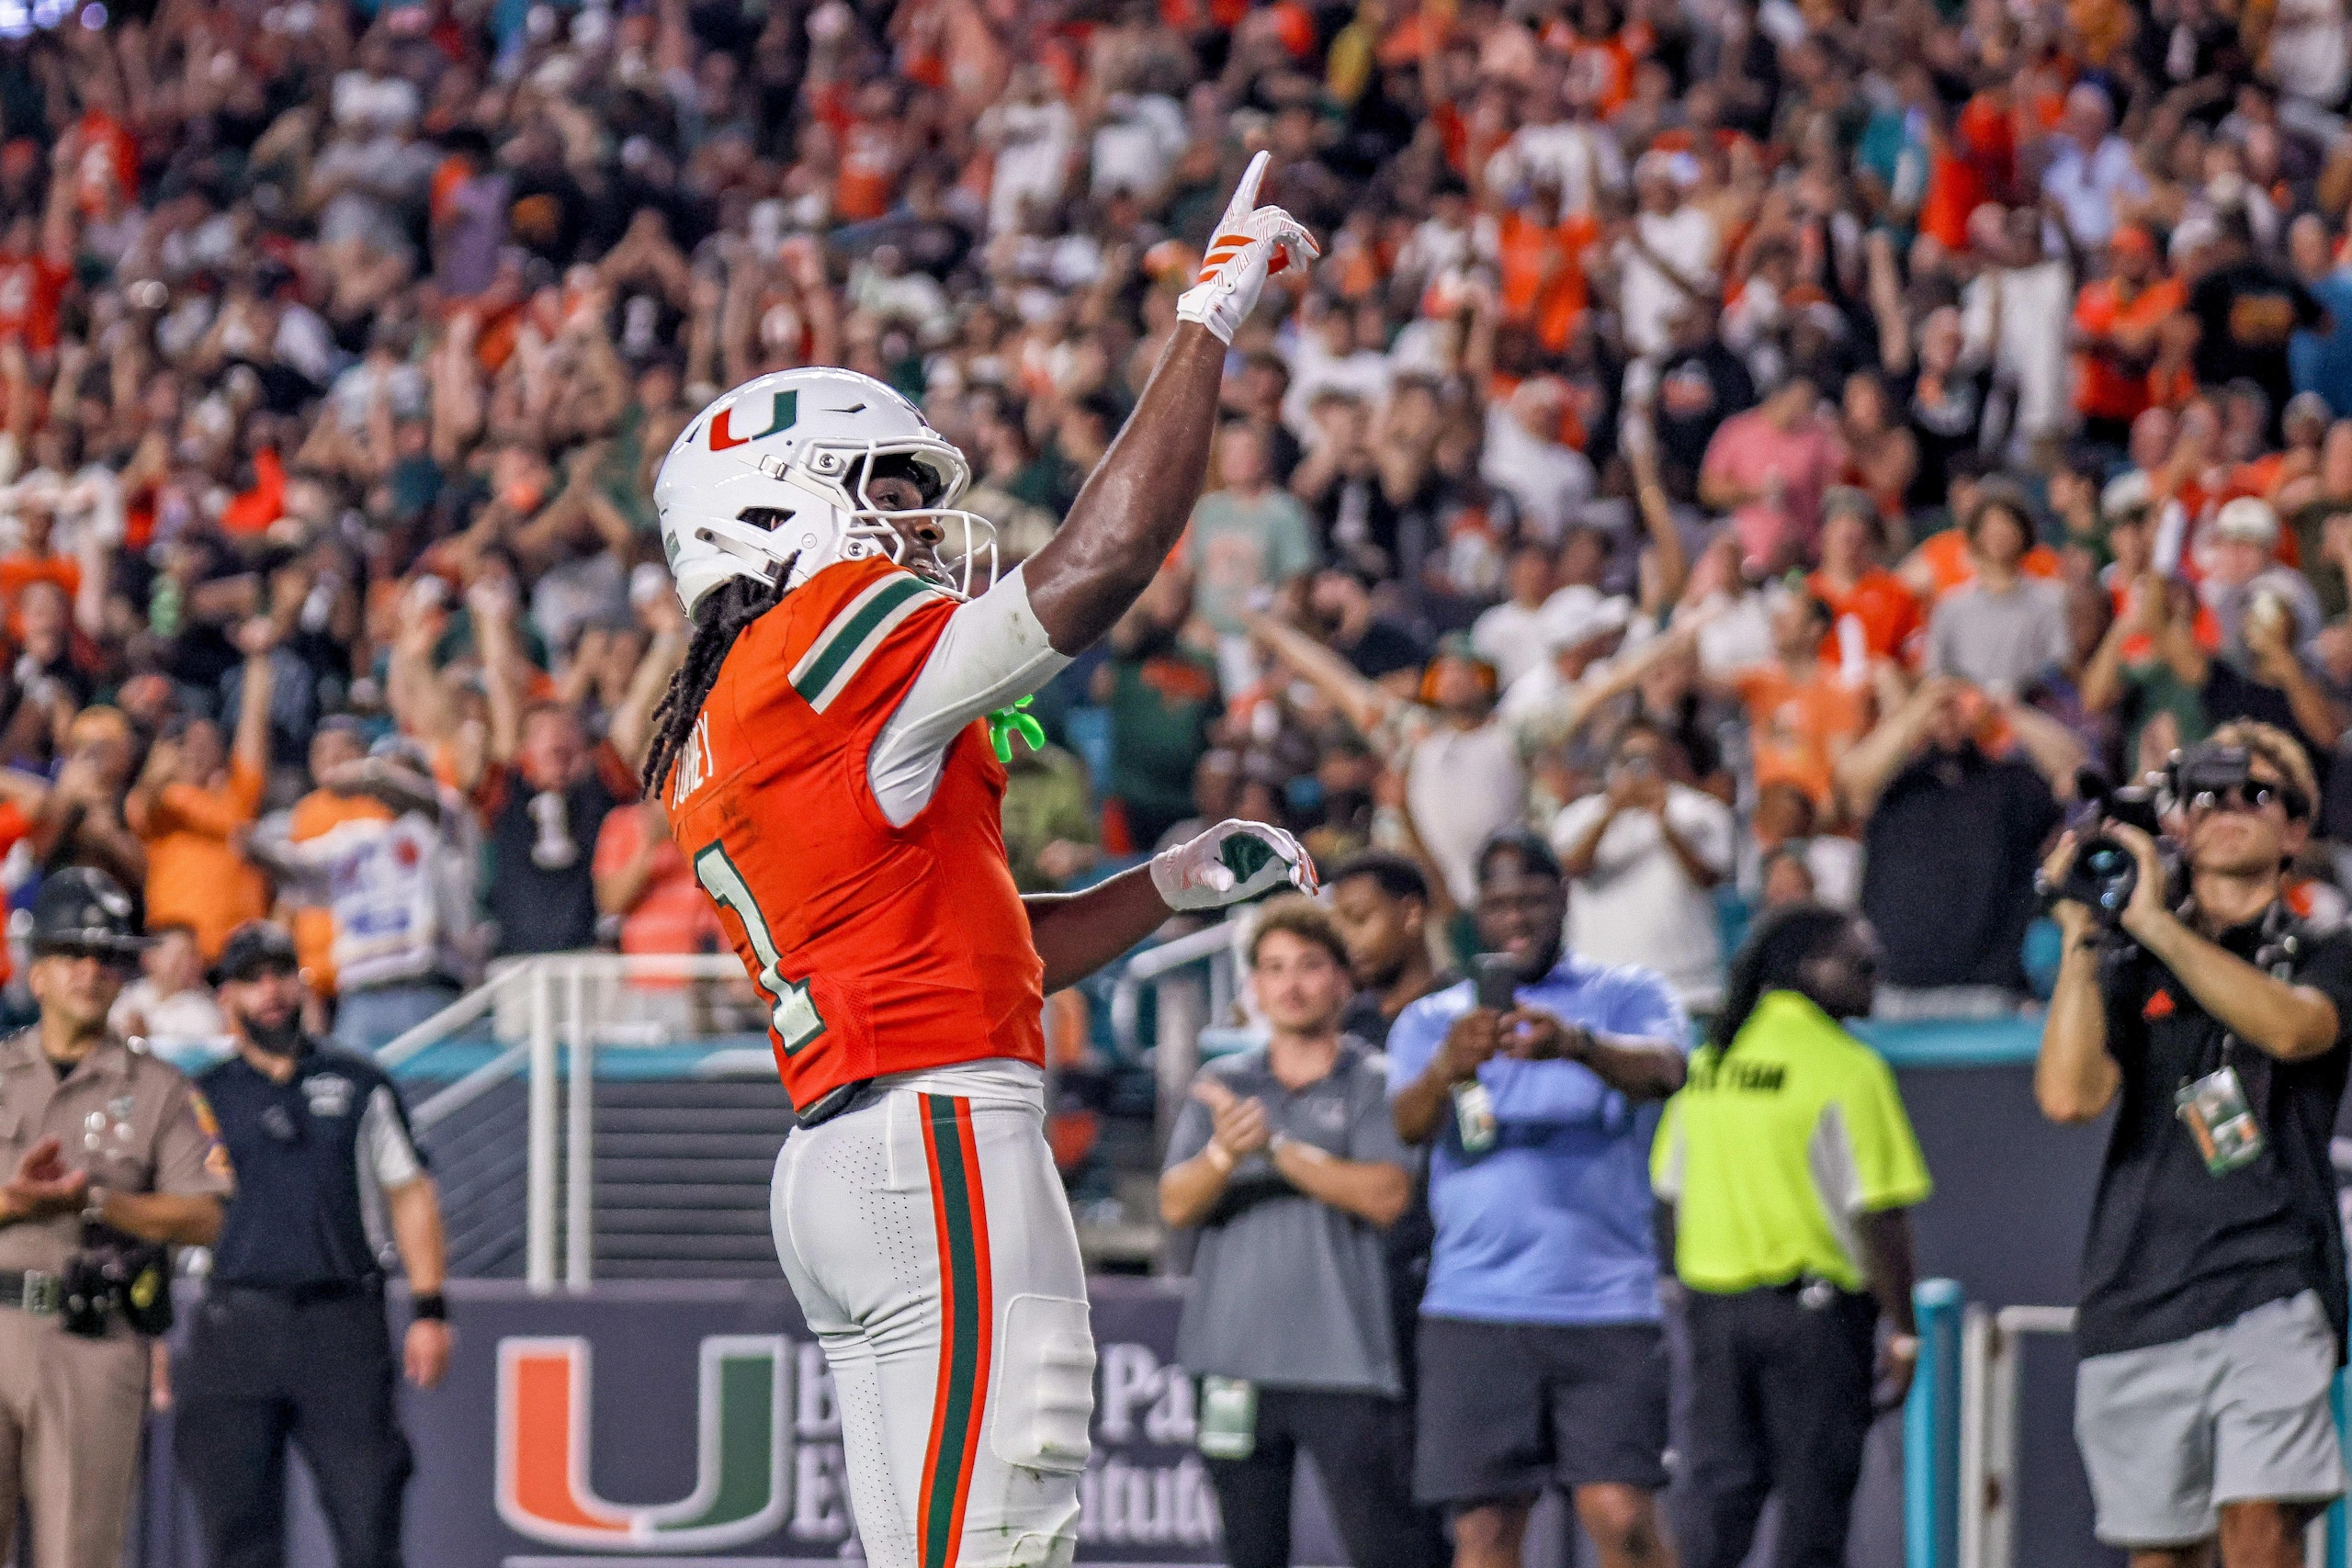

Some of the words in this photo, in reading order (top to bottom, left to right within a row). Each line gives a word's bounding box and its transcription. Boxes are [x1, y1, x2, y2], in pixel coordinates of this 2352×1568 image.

[709, 389, 797, 451] U
[694, 838, 827, 1057] 1
[496, 1335, 794, 1552] U
